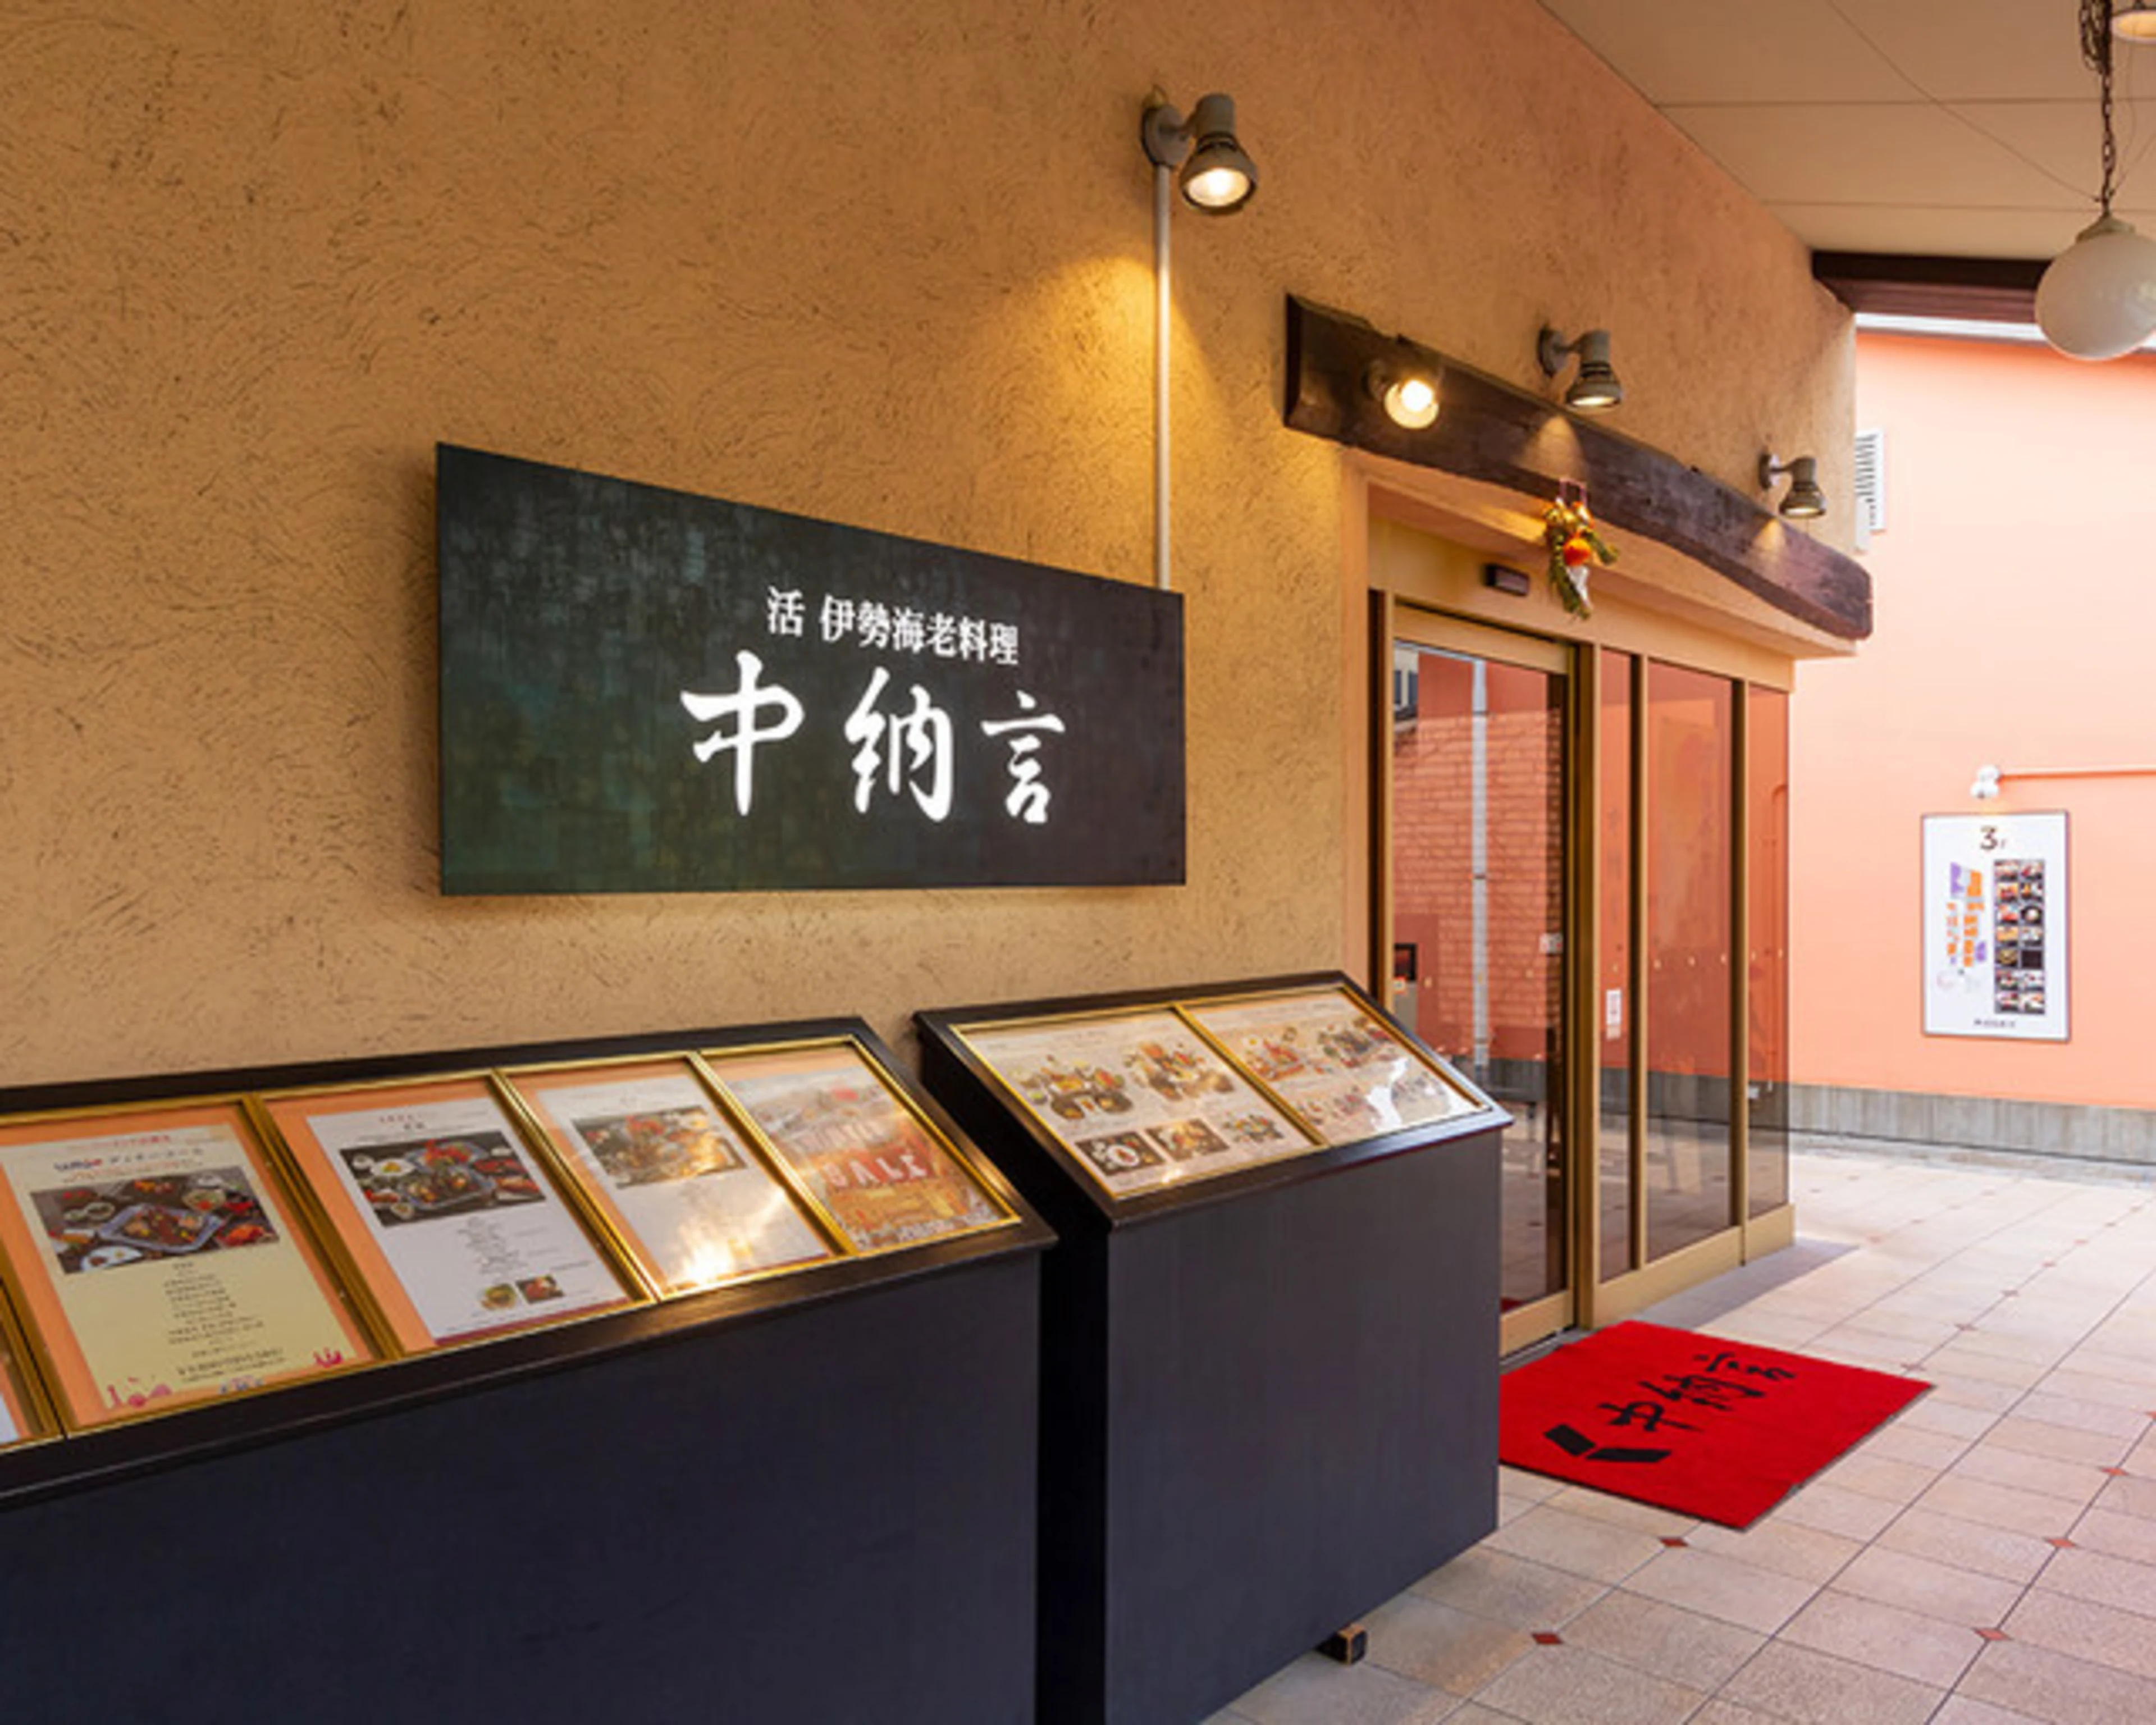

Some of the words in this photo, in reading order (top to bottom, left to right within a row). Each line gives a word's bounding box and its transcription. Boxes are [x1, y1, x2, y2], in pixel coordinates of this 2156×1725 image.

[767, 586, 805, 637] 活
[819, 594, 1019, 665] 伊勢海老料理
[680, 650, 1065, 823] 中納言
[823, 1153, 928, 1188] SALE
